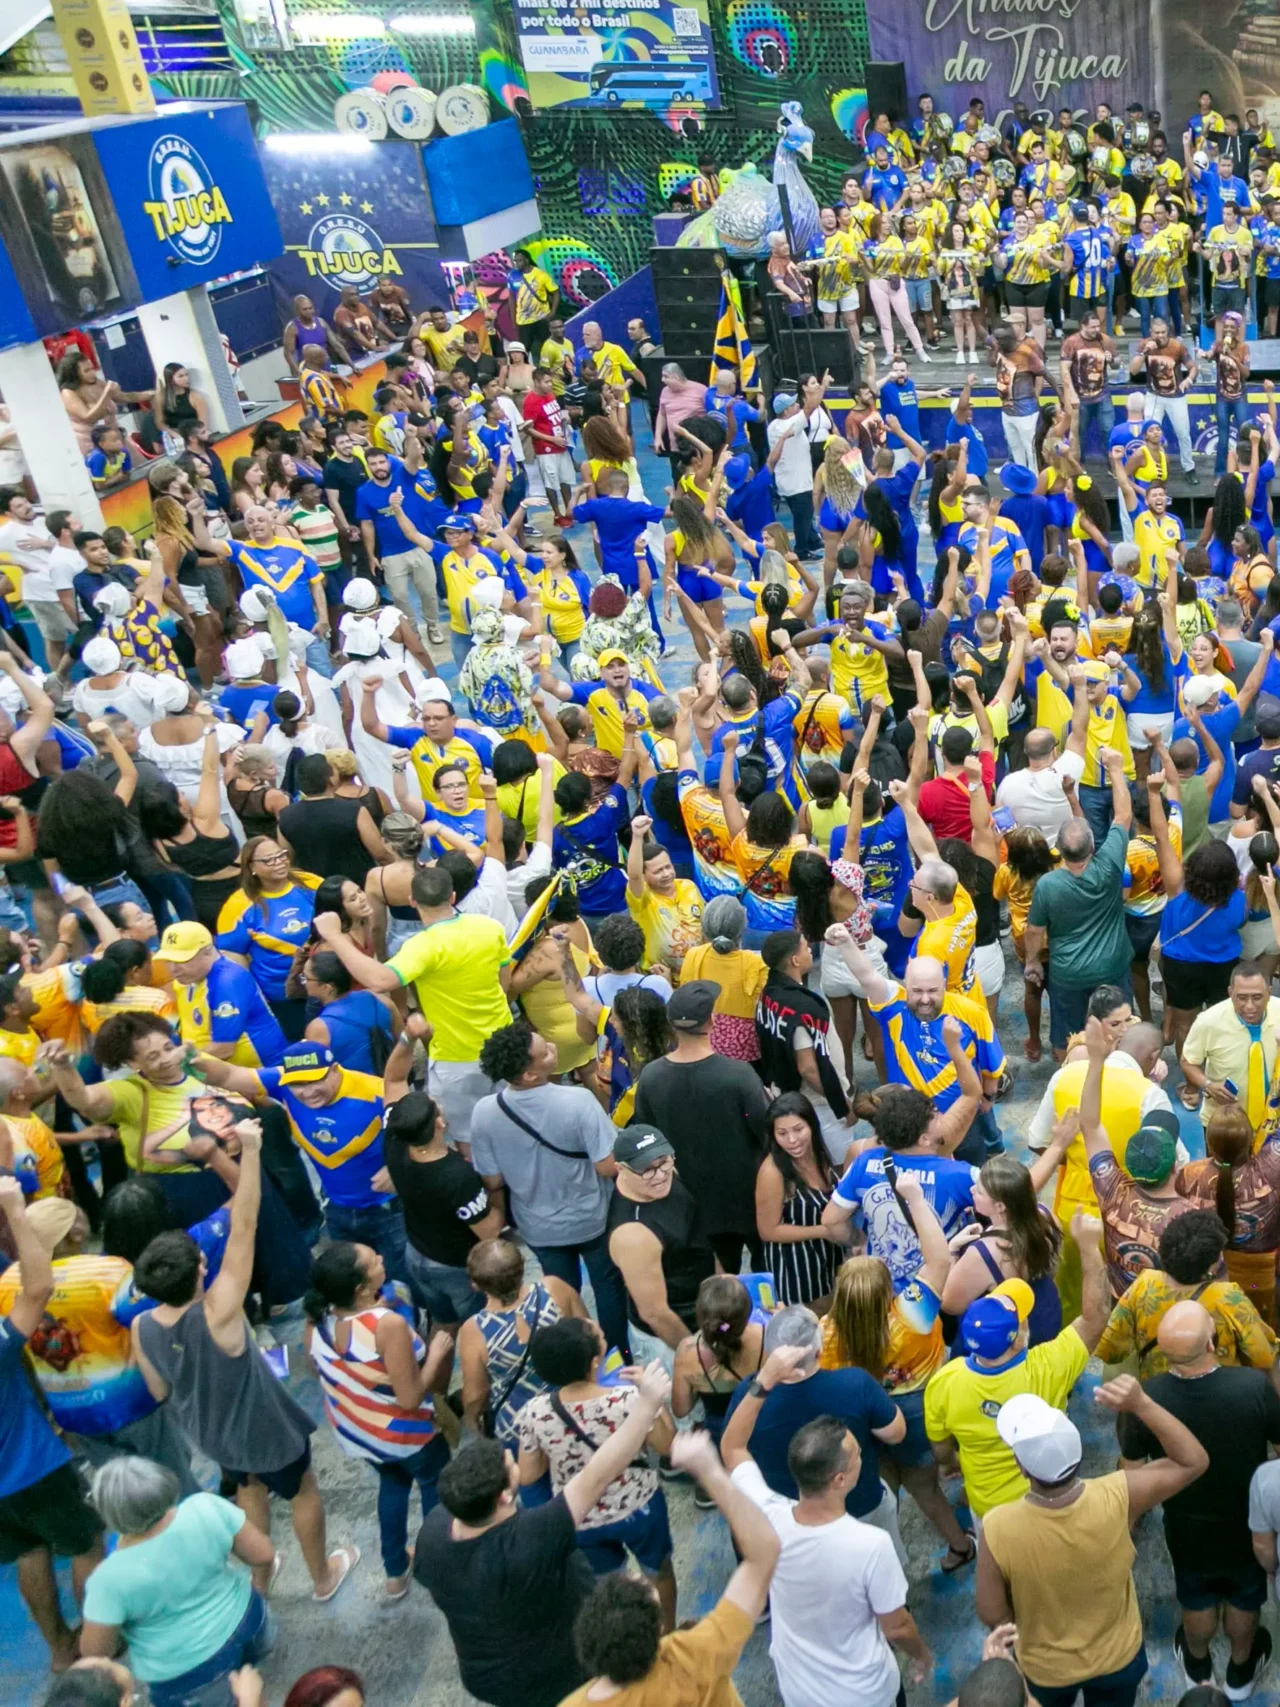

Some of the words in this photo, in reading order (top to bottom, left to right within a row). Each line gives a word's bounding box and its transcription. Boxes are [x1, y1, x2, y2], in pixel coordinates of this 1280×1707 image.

[521, 15, 546, 29] por
[548, 13, 580, 28] todo
[581, 15, 591, 27] o
[593, 13, 631, 28] Brasil
[528, 45, 590, 56] GUANABARA
[944, 40, 993, 82] da
[985, 23, 1127, 102] Tijuca
[143, 185, 234, 242] TIJUCA
[297, 249, 405, 277] TIJUCA
